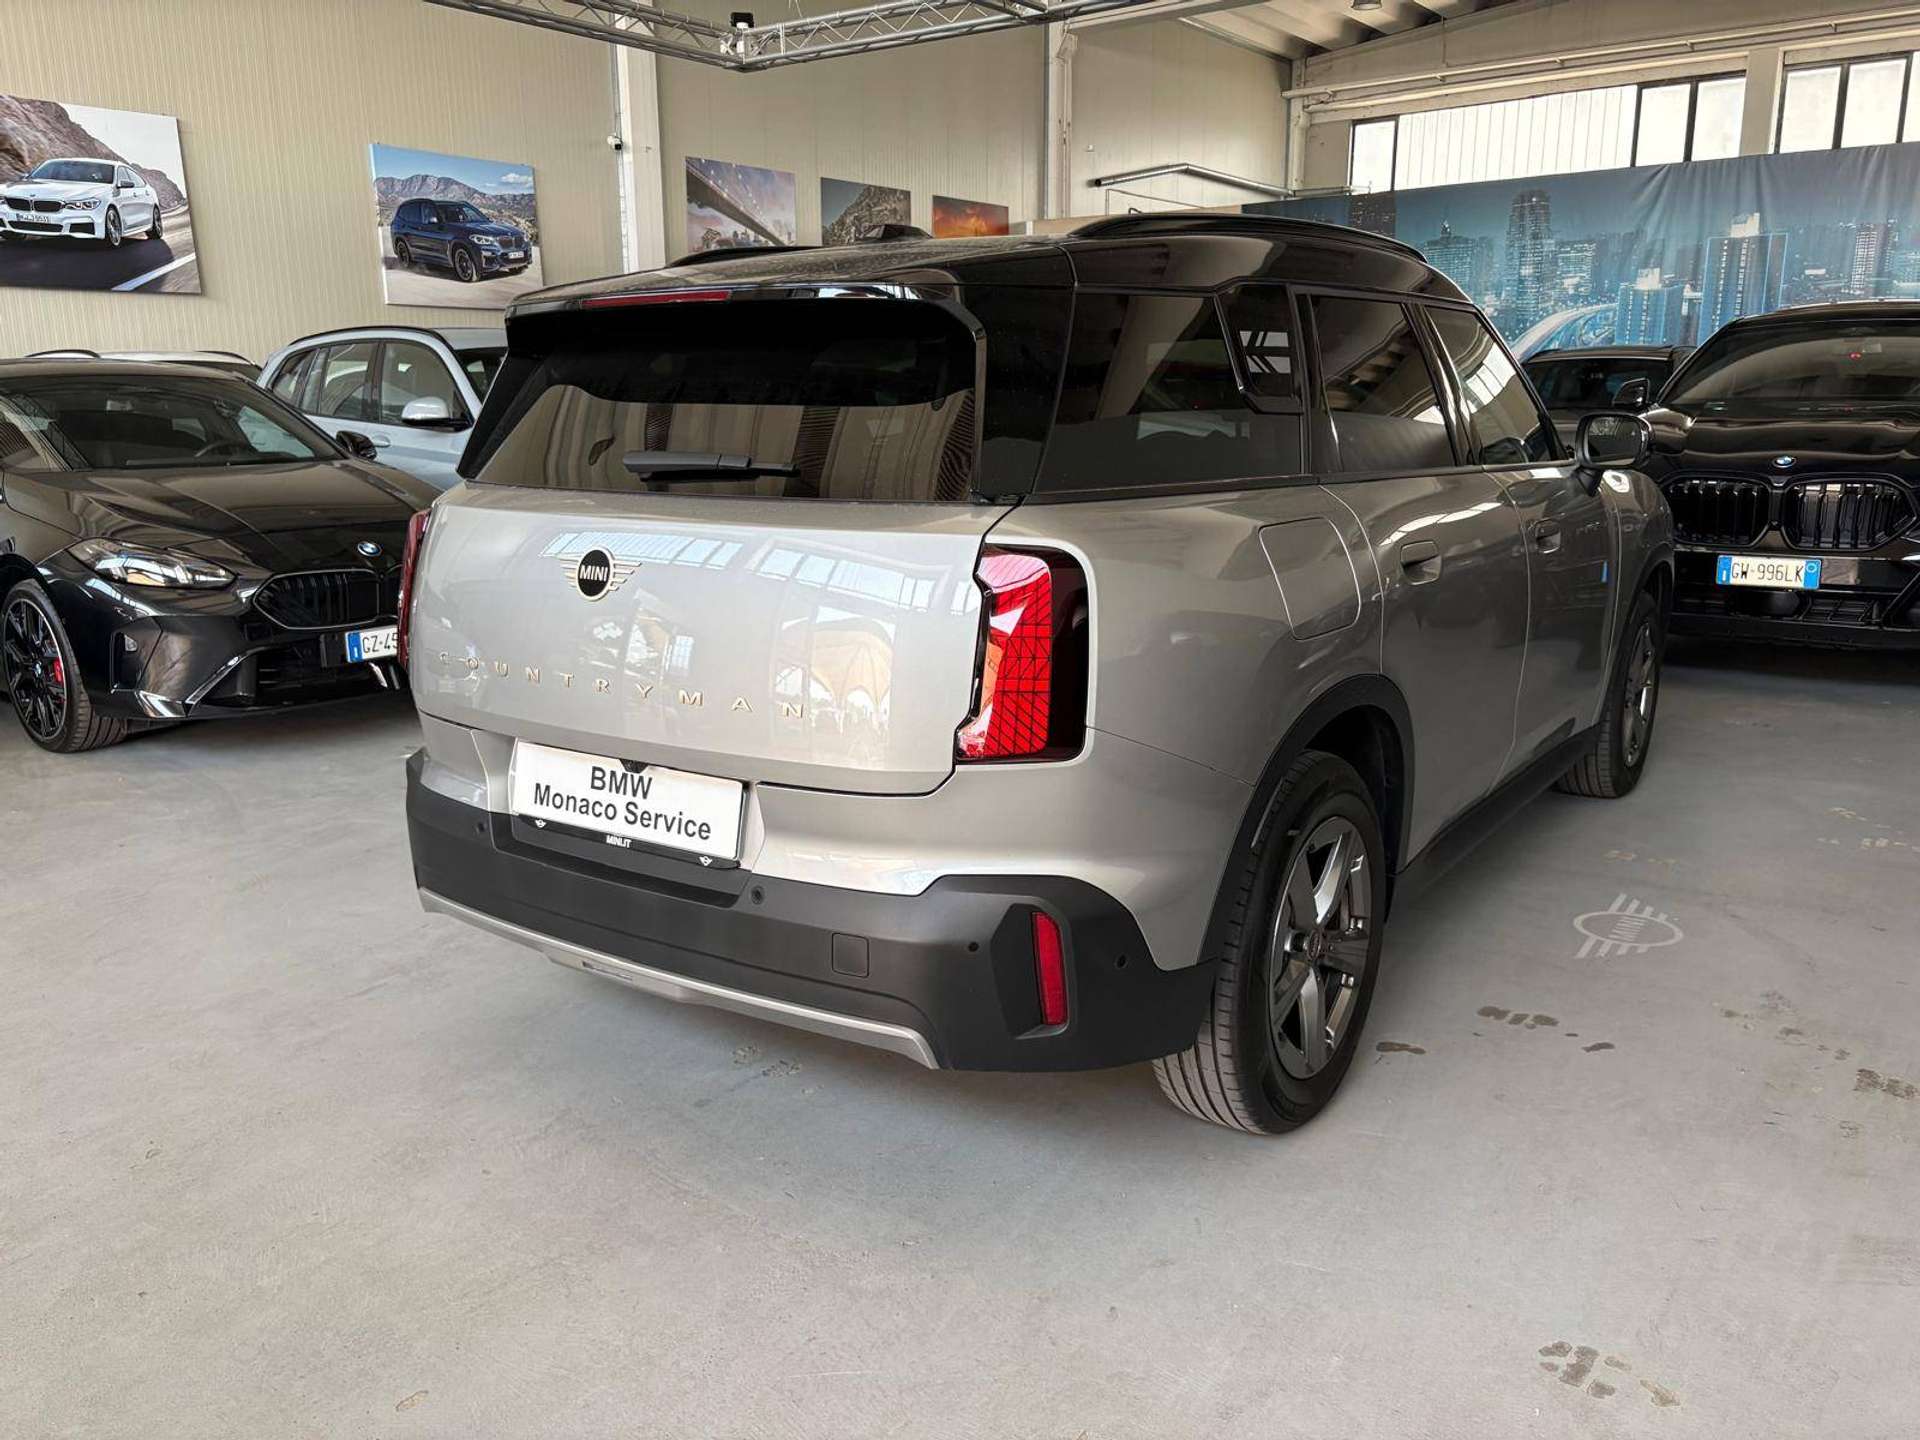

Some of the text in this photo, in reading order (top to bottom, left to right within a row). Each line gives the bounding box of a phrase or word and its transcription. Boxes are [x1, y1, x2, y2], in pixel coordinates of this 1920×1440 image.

[579, 564, 608, 582] MINI
[439, 651, 804, 719] COUNTRYMAN
[590, 765, 653, 800] BMW
[533, 782, 712, 841] Monaco Service
